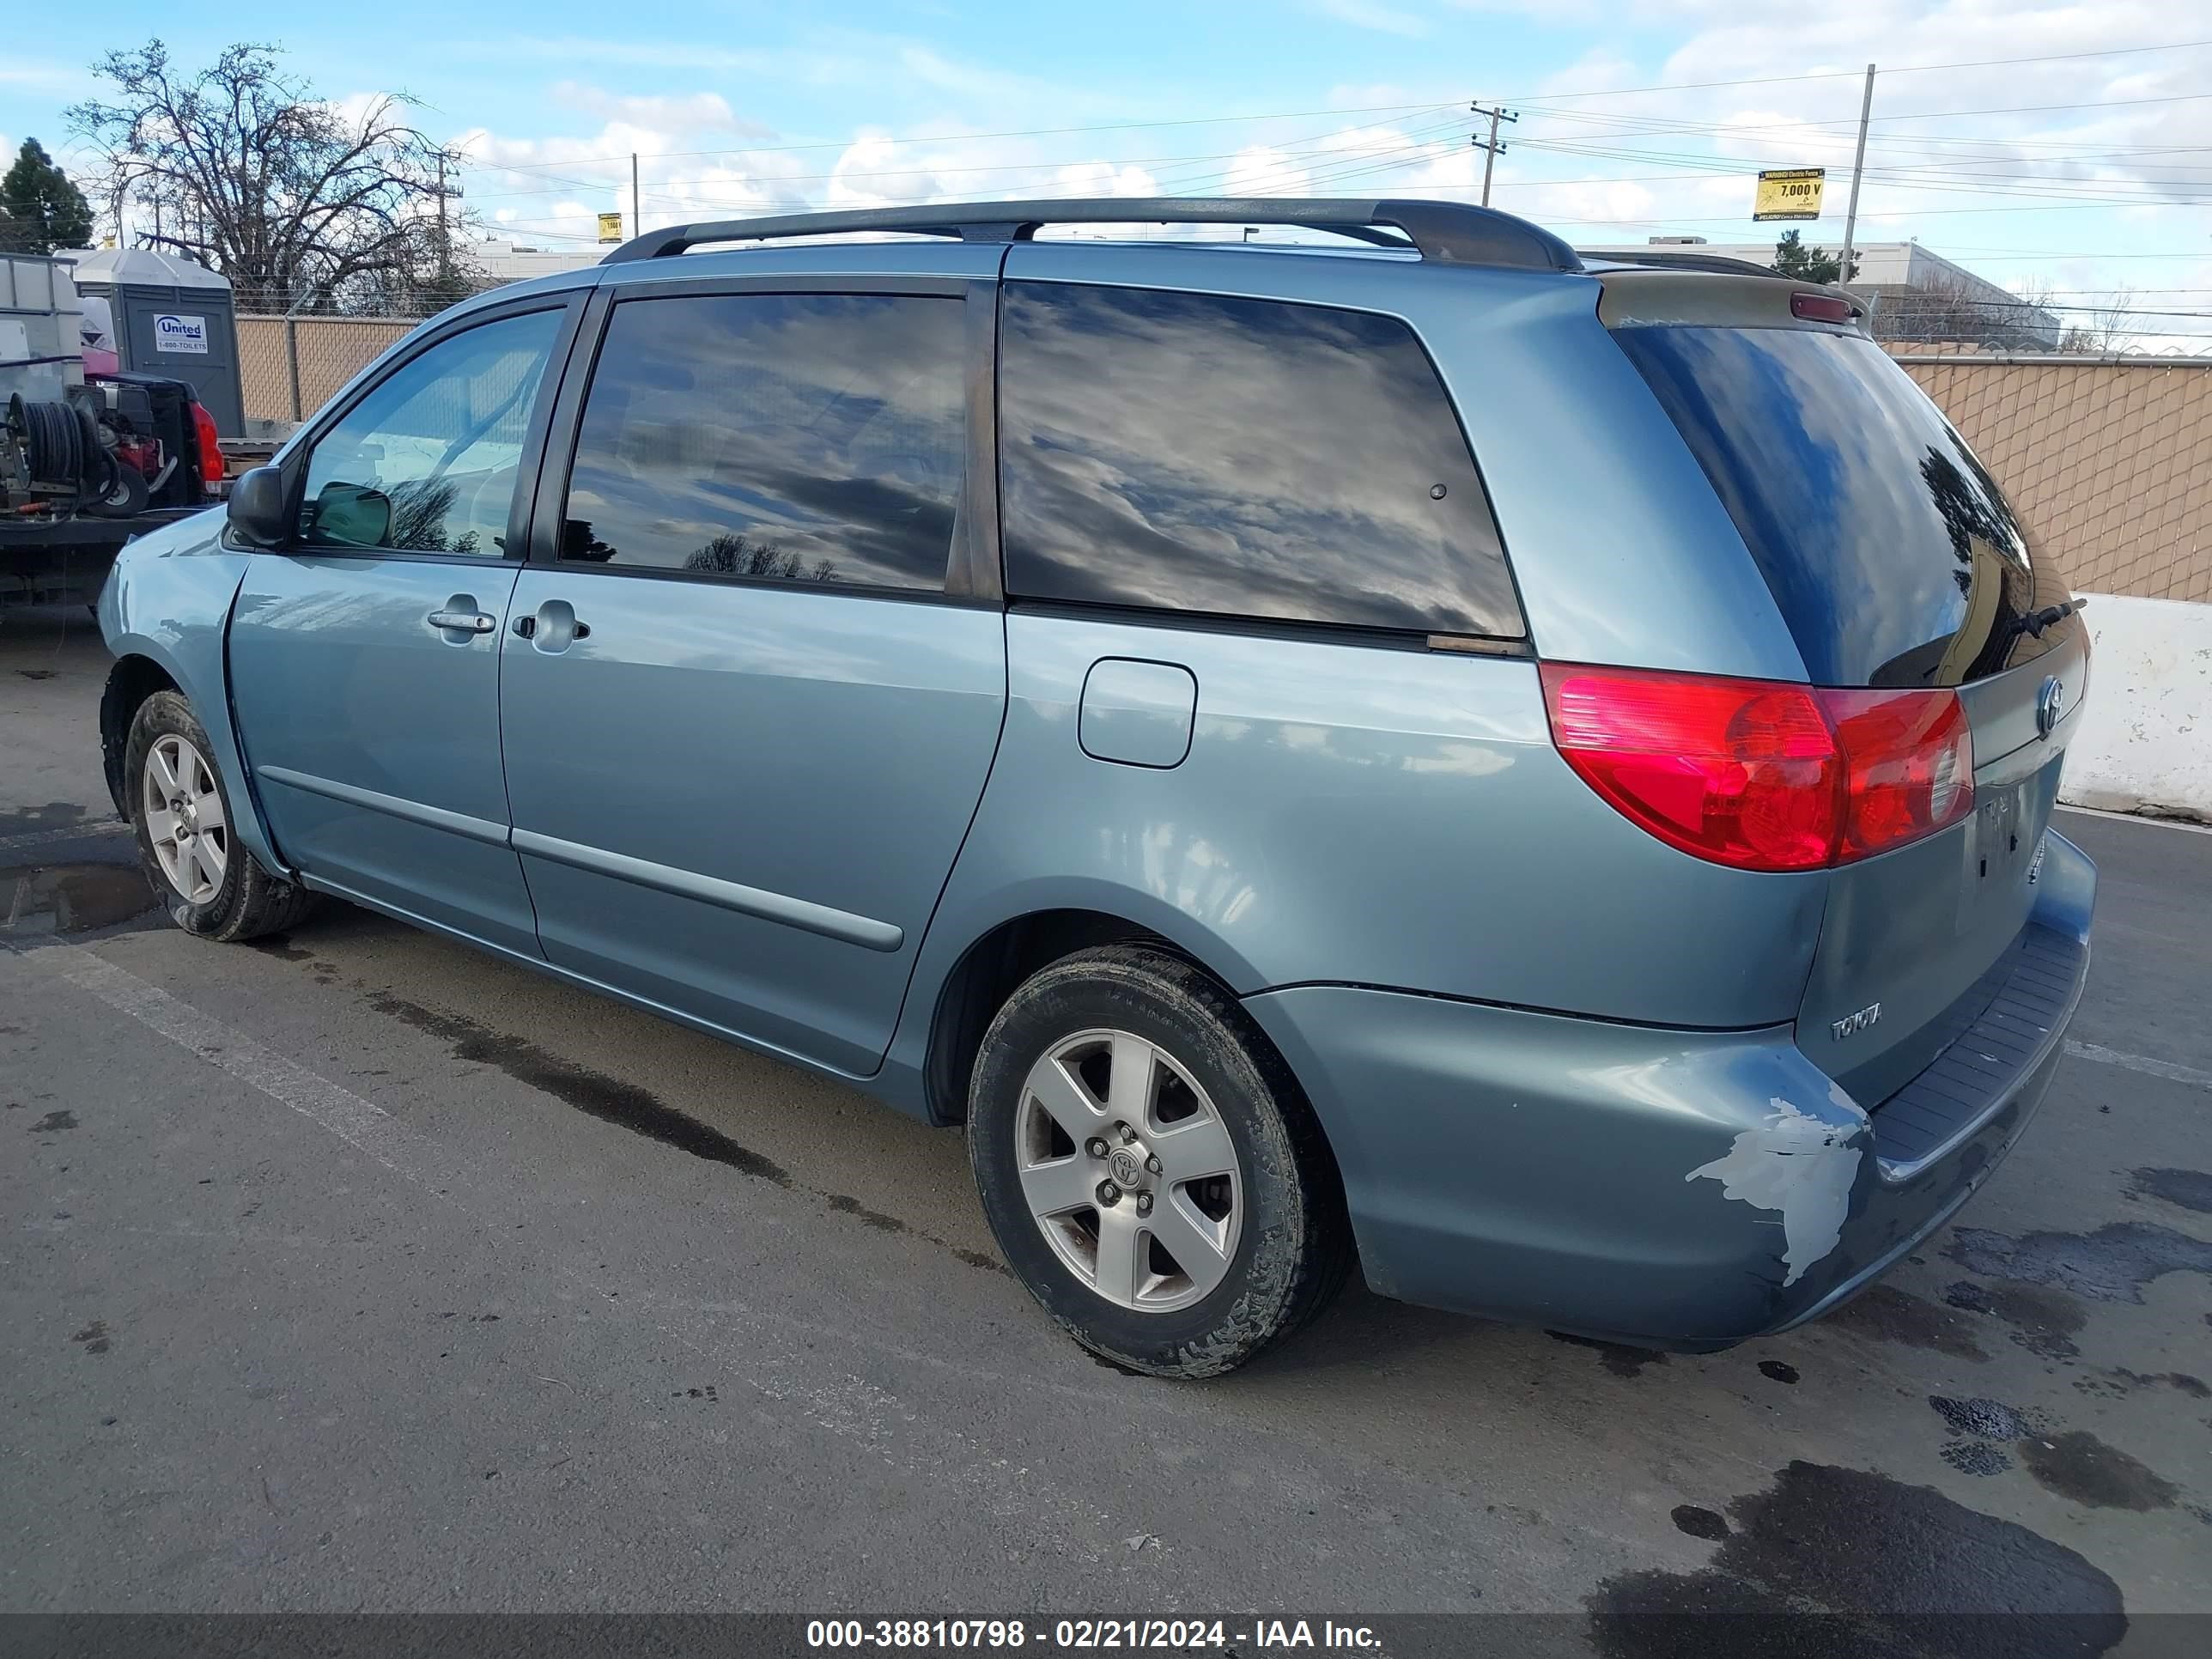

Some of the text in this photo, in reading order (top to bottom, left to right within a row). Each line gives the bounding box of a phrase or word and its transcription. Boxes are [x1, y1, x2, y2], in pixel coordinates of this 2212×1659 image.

[1781, 184, 1821, 198] 7,000 V
[161, 322, 201, 334] United
[1829, 1002, 1882, 1041] TOYOTA
